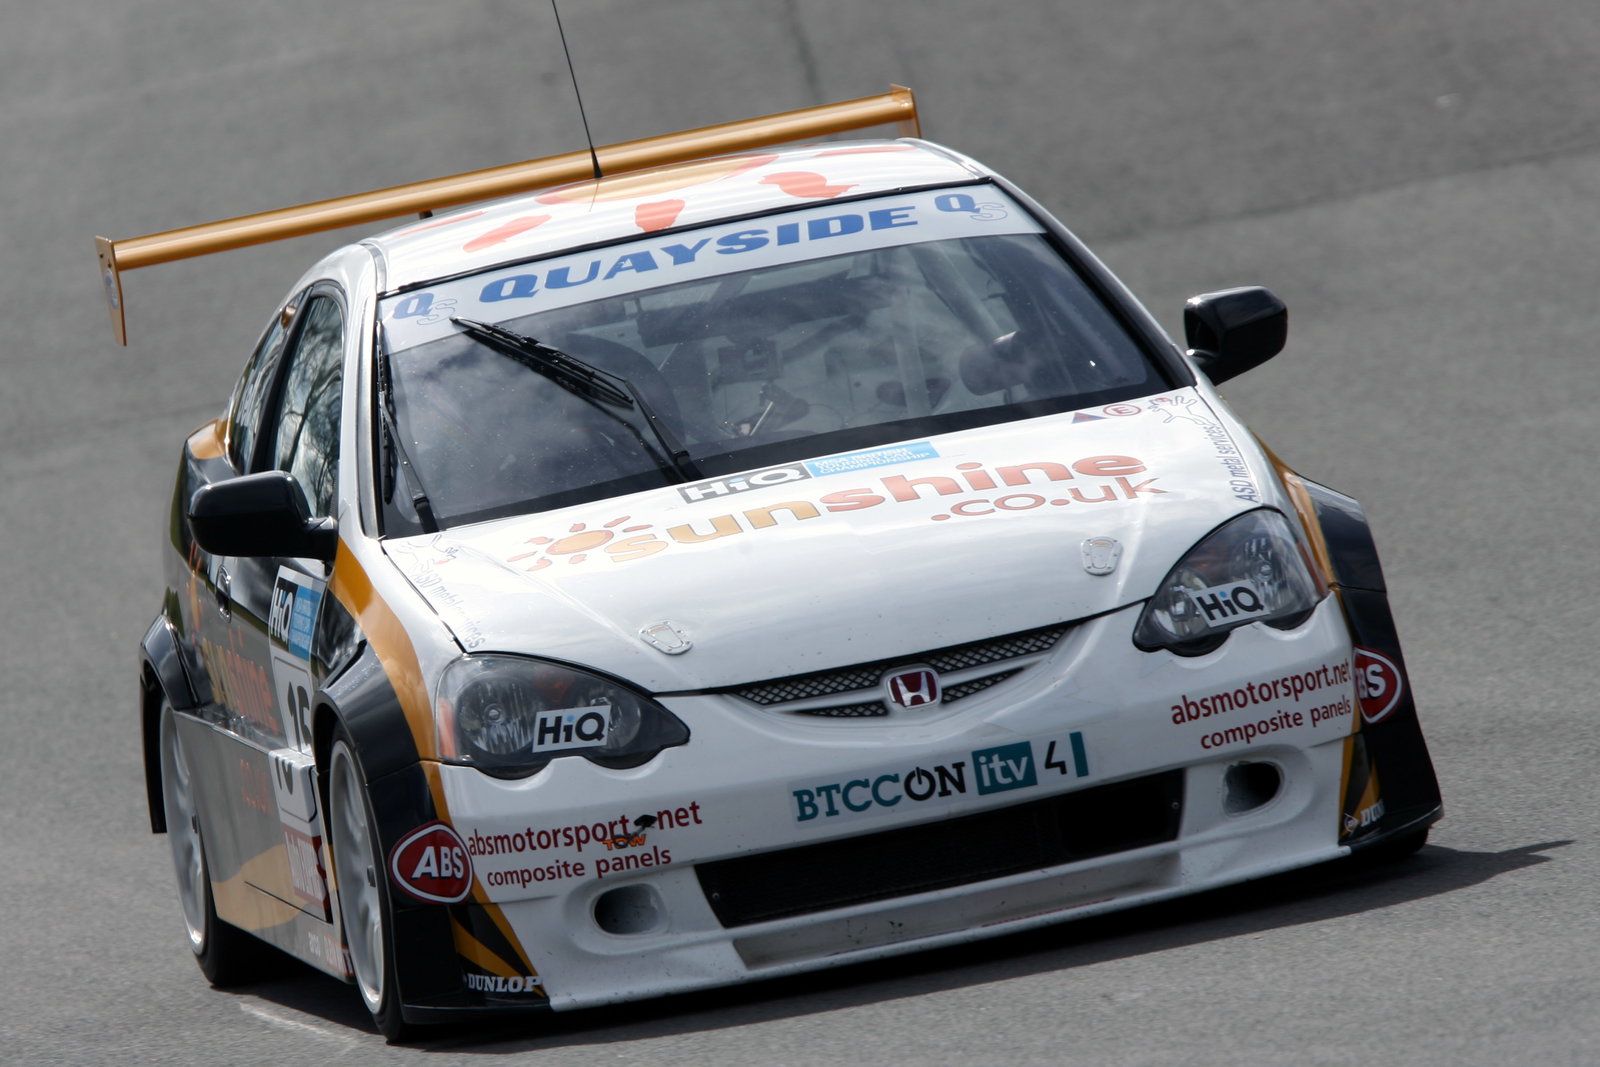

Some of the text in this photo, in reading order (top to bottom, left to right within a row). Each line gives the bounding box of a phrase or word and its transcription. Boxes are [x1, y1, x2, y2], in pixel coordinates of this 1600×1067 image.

[479, 205, 918, 303] QUAYSIDE
[687, 468, 805, 501] HiQ
[1216, 456, 1249, 478] metal
[604, 455, 1148, 562] sunshine
[930, 477, 1169, 521] .co.uk
[1229, 480, 1259, 503] ASD
[269, 587, 294, 645] HiQ
[1195, 586, 1264, 621] HiQ
[1171, 657, 1352, 725] absmotorsport.net
[537, 711, 605, 746] HiQ
[1201, 694, 1352, 750] composite panels
[978, 754, 1028, 787] itv
[468, 801, 703, 857] absmotorsportnet
[411, 846, 465, 880] ABS
[487, 846, 672, 889] composite panels
[466, 975, 543, 993] DUNLOP
